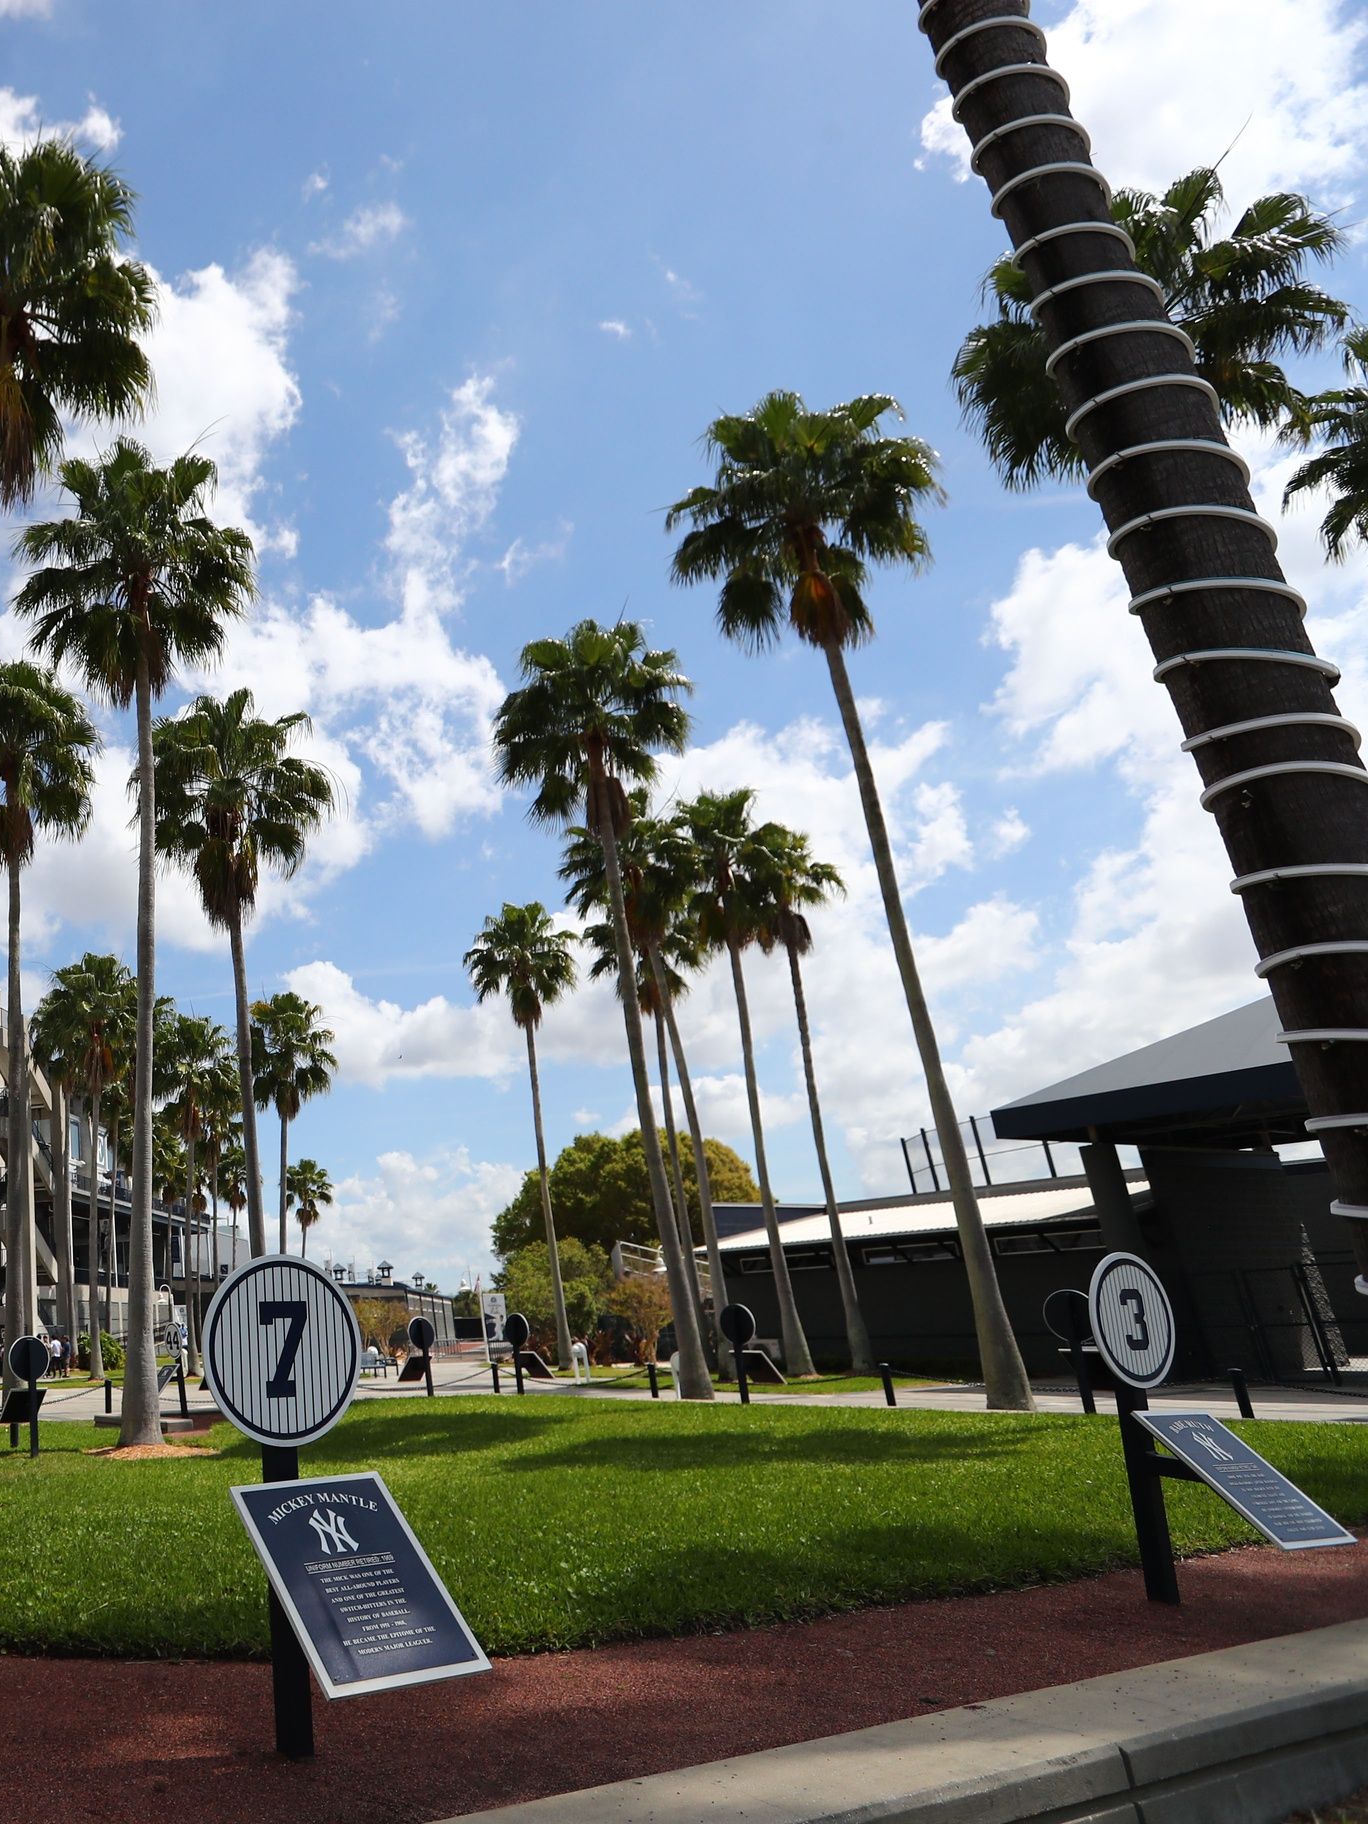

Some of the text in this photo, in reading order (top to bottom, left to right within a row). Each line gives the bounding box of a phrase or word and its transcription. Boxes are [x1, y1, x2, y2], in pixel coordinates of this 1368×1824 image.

[1119, 1288, 1150, 1351] 3
[167, 1331, 180, 1350] 44
[259, 1301, 307, 1398] 7
[267, 1492, 379, 1525] MICKEY MANTLE
[305, 1562, 332, 1572] UNIFORM
[331, 1559, 356, 1568] NUMBER
[374, 1577, 400, 1585] PLAYERS
